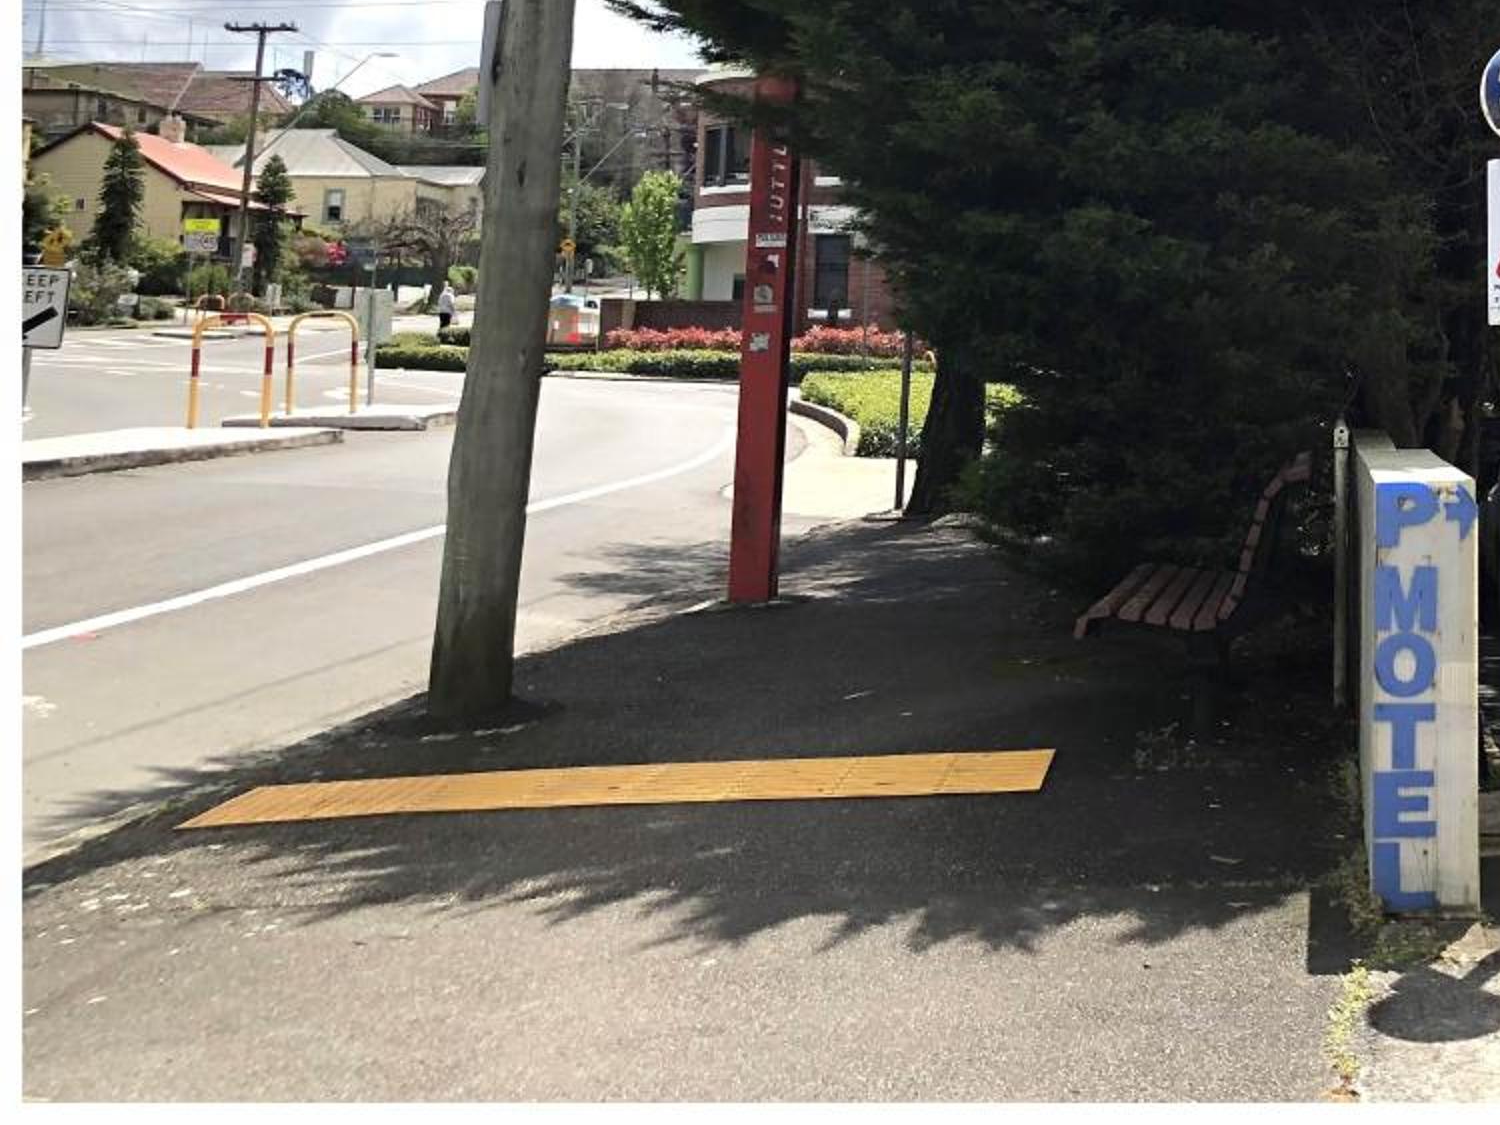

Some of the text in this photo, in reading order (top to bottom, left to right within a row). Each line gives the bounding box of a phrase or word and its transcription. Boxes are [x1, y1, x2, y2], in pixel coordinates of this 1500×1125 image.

[23, 290, 56, 303] EFT
[25, 274, 60, 286] EEP
[1375, 482, 1440, 548] P
[1373, 565, 1440, 913] MOTEL
